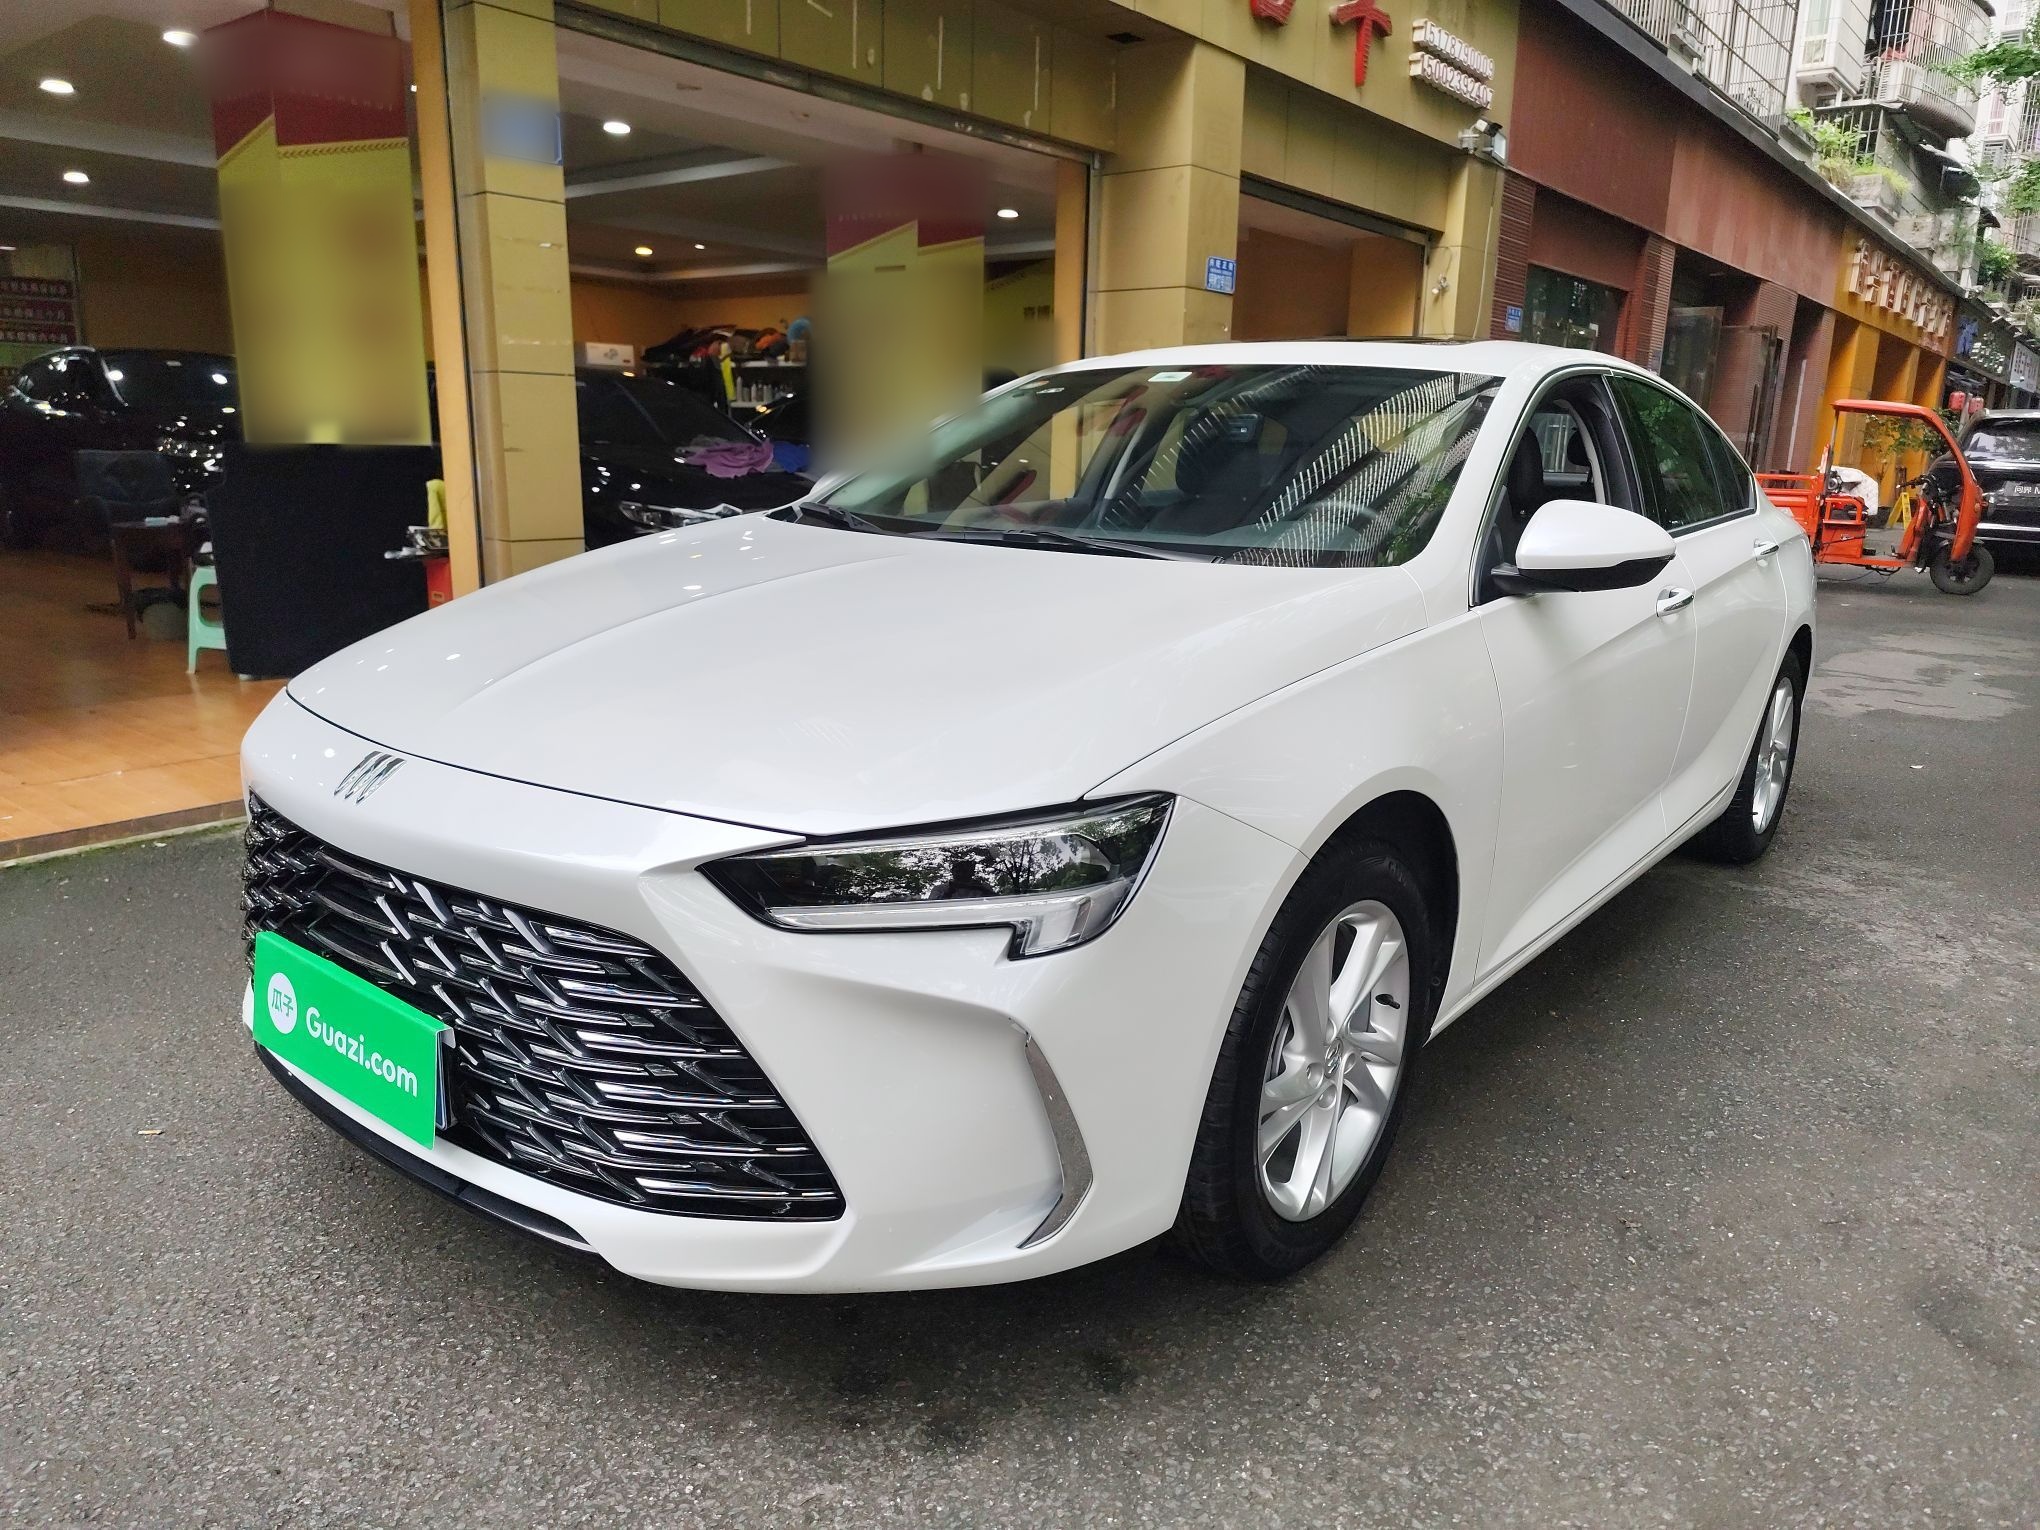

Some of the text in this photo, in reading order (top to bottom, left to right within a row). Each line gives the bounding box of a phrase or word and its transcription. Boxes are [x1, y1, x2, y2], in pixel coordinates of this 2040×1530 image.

[1413, 18, 1495, 80] 15178790009
[1409, 51, 1495, 110] 15002392407
[2014, 485, 2032, 494] 问界
[271, 987, 418, 1098] 瓜子 Guazi.com
